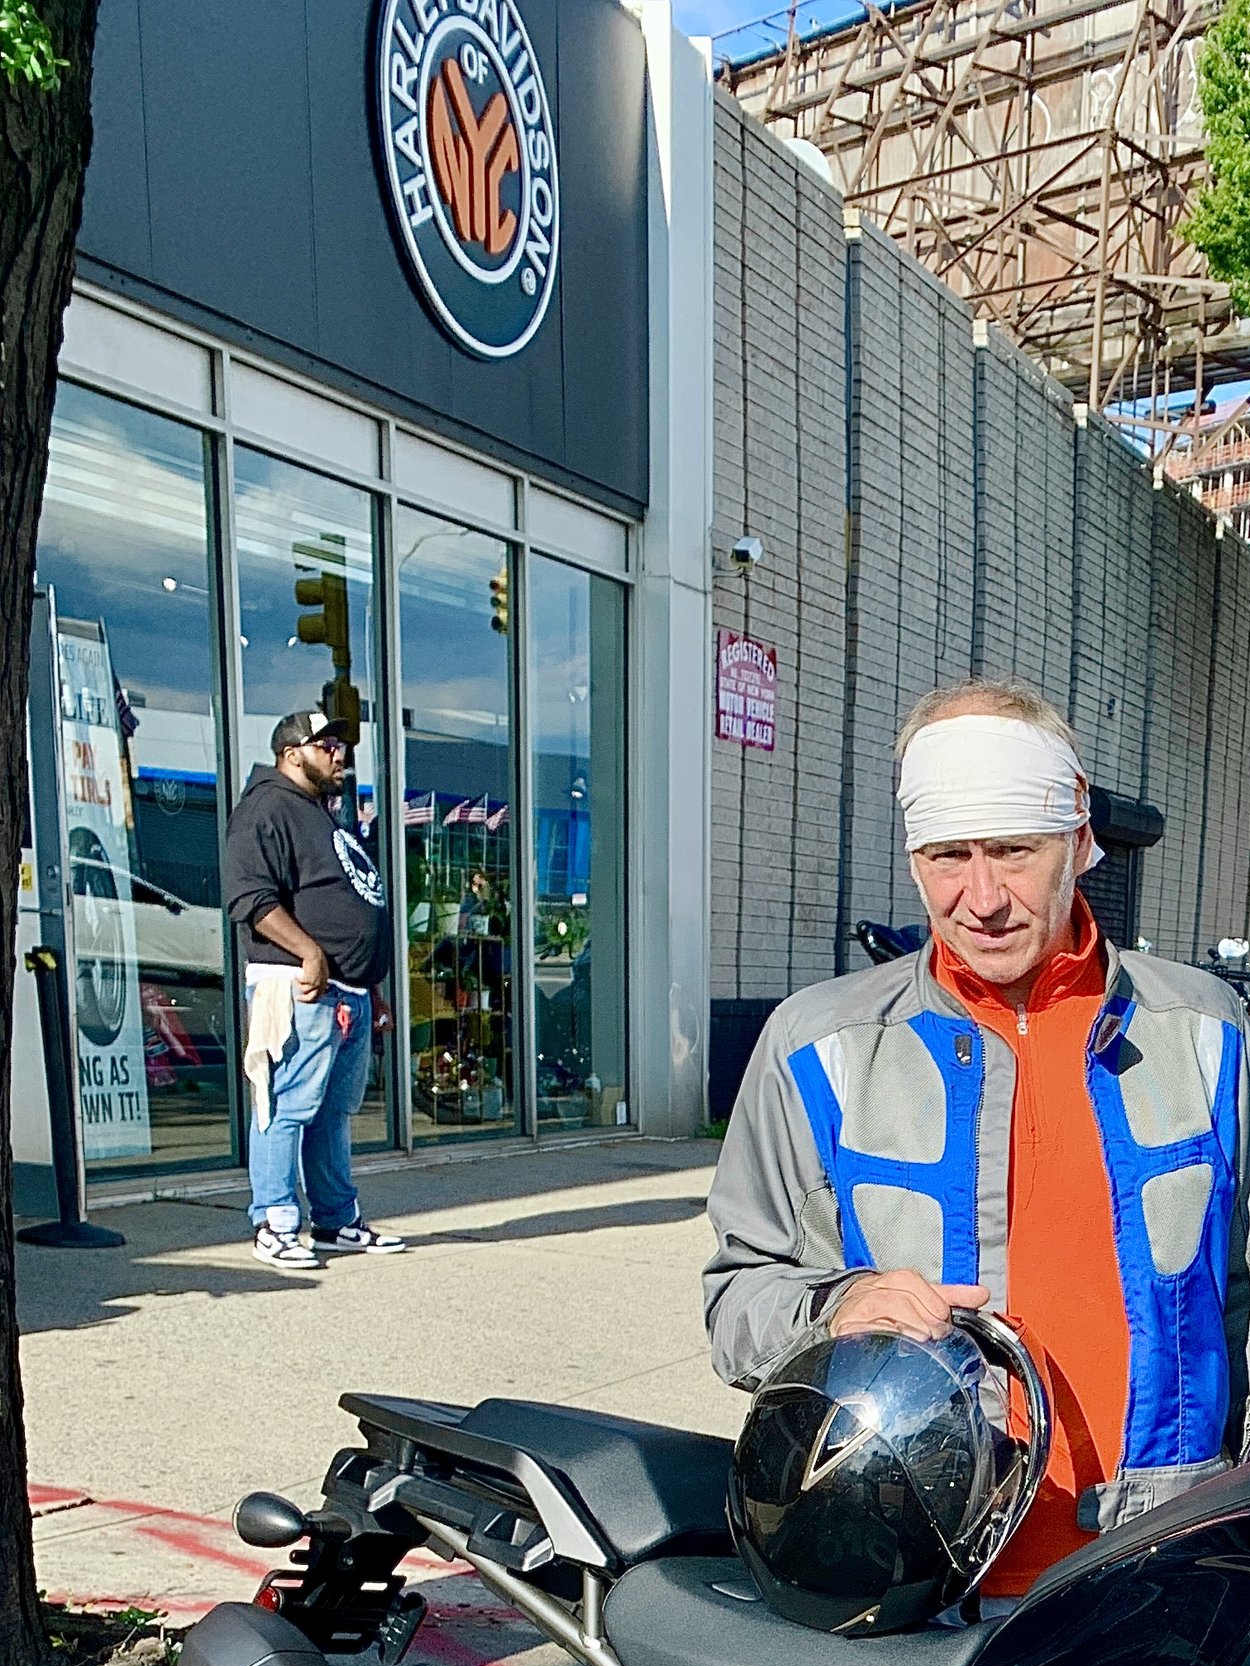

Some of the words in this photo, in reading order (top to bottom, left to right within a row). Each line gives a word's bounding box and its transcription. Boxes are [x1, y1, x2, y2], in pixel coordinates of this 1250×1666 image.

[461, 43, 488, 84] OF
[391, 0, 552, 278] HARLEAVIDSON
[721, 640, 776, 682] REGISTERED
[80, 1055, 104, 1087] NG
[110, 1055, 130, 1086] AS
[82, 1092, 113, 1124] WN
[118, 1091, 142, 1121] IT!
